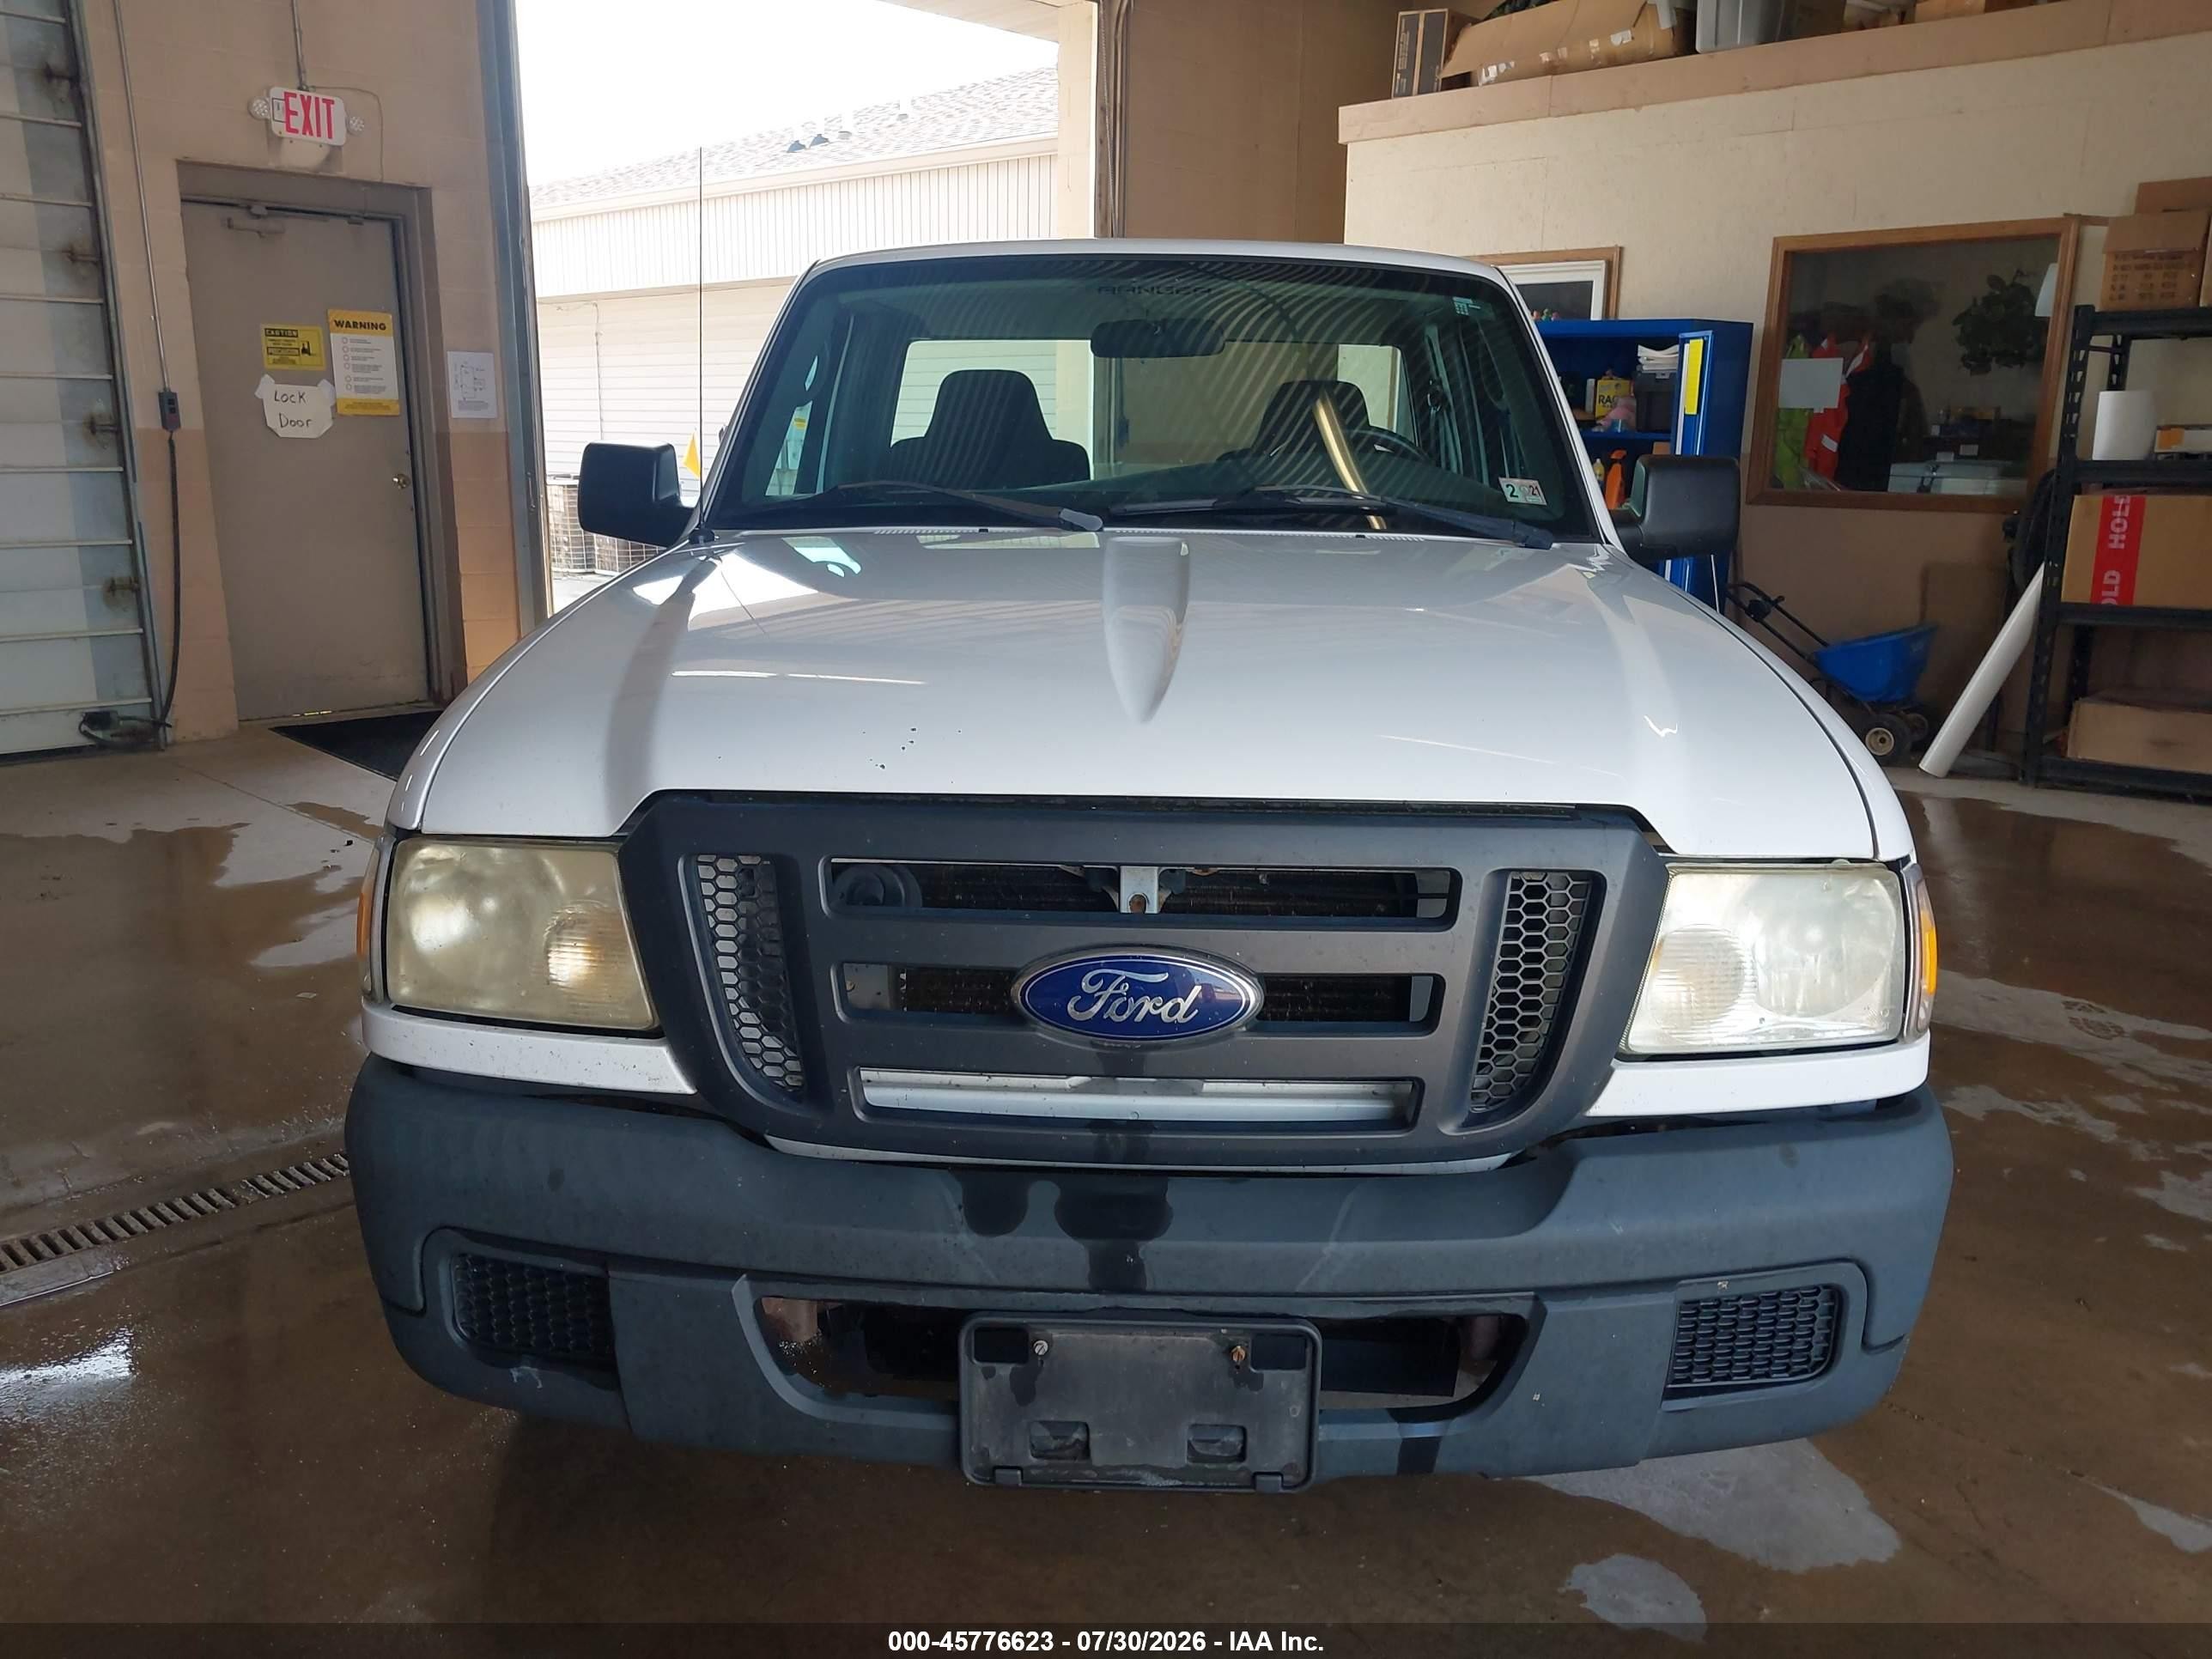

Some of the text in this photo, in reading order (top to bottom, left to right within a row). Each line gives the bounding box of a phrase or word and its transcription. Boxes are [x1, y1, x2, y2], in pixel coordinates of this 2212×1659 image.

[283, 92, 335, 139] EXIT
[334, 319, 386, 331] WARNING
[279, 412, 312, 428] Door
[1505, 483, 1519, 498] 2
[1528, 485, 1544, 501] 21
[1067, 968, 1202, 1024] Ford
